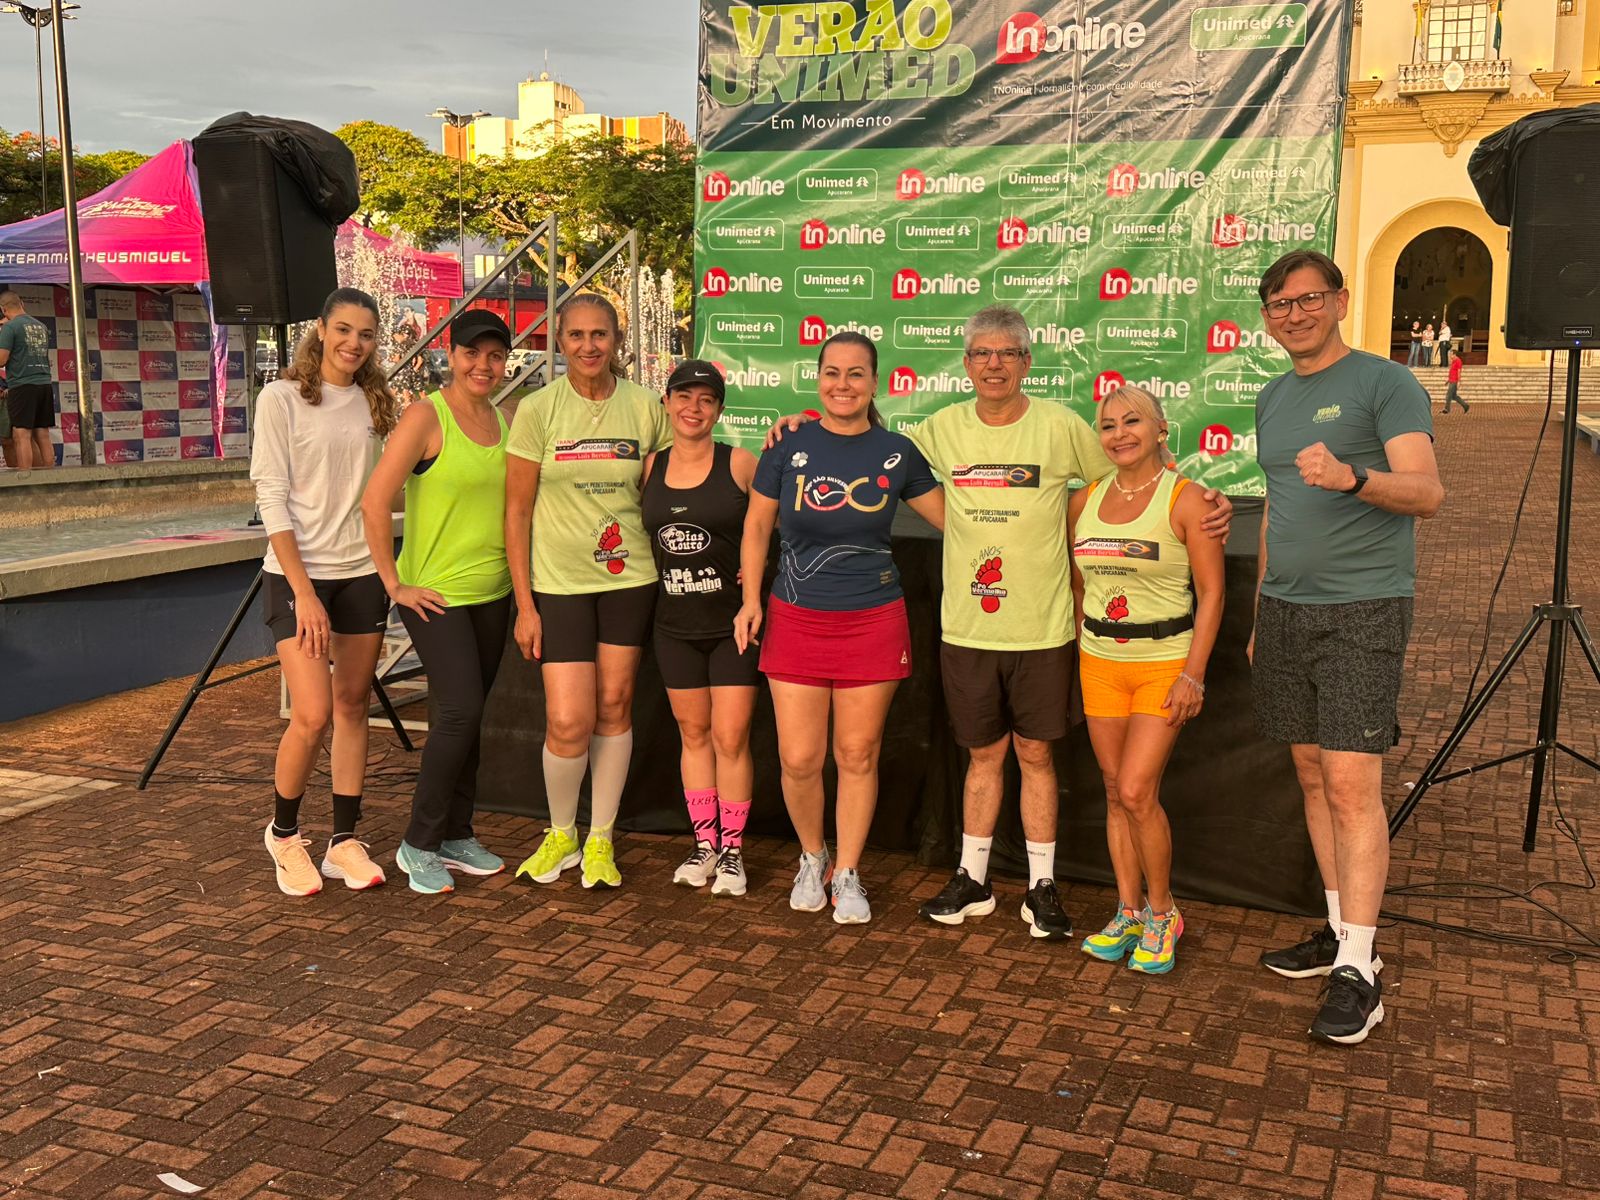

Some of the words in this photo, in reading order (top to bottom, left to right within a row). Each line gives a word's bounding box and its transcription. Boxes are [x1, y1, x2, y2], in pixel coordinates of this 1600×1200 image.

[1203, 16, 1272, 32] Unimed
[710, 44, 976, 106] UNIMED
[771, 115, 795, 129] Em
[802, 114, 892, 129] Movimento
[1008, 173, 1060, 184] Unimed
[1231, 167, 1288, 179] Unimed
[708, 176, 785, 196] tnonline
[806, 177, 853, 188] Unimed
[901, 173, 986, 194] tnonline
[716, 226, 761, 237] Unimed
[805, 224, 887, 245] tnonline
[905, 225, 955, 237] Unimed
[1112, 223, 1166, 234] Unimed
[707, 271, 783, 293] tnonline
[803, 274, 850, 285] Unimed
[897, 273, 981, 295] tnonline
[1003, 275, 1053, 286] Unimed
[1105, 272, 1198, 295] tnonline
[1223, 275, 1261, 287] Unim
[717, 321, 761, 333] Unimed
[903, 325, 951, 337] Unimed
[1028, 323, 1086, 345] nline
[1107, 327, 1160, 339] Unimed
[725, 367, 781, 387] online
[1020, 375, 1048, 386] med
[1205, 428, 1257, 452] tnon
[670, 567, 693, 583] Pé
[664, 577, 722, 593] Vermelho
